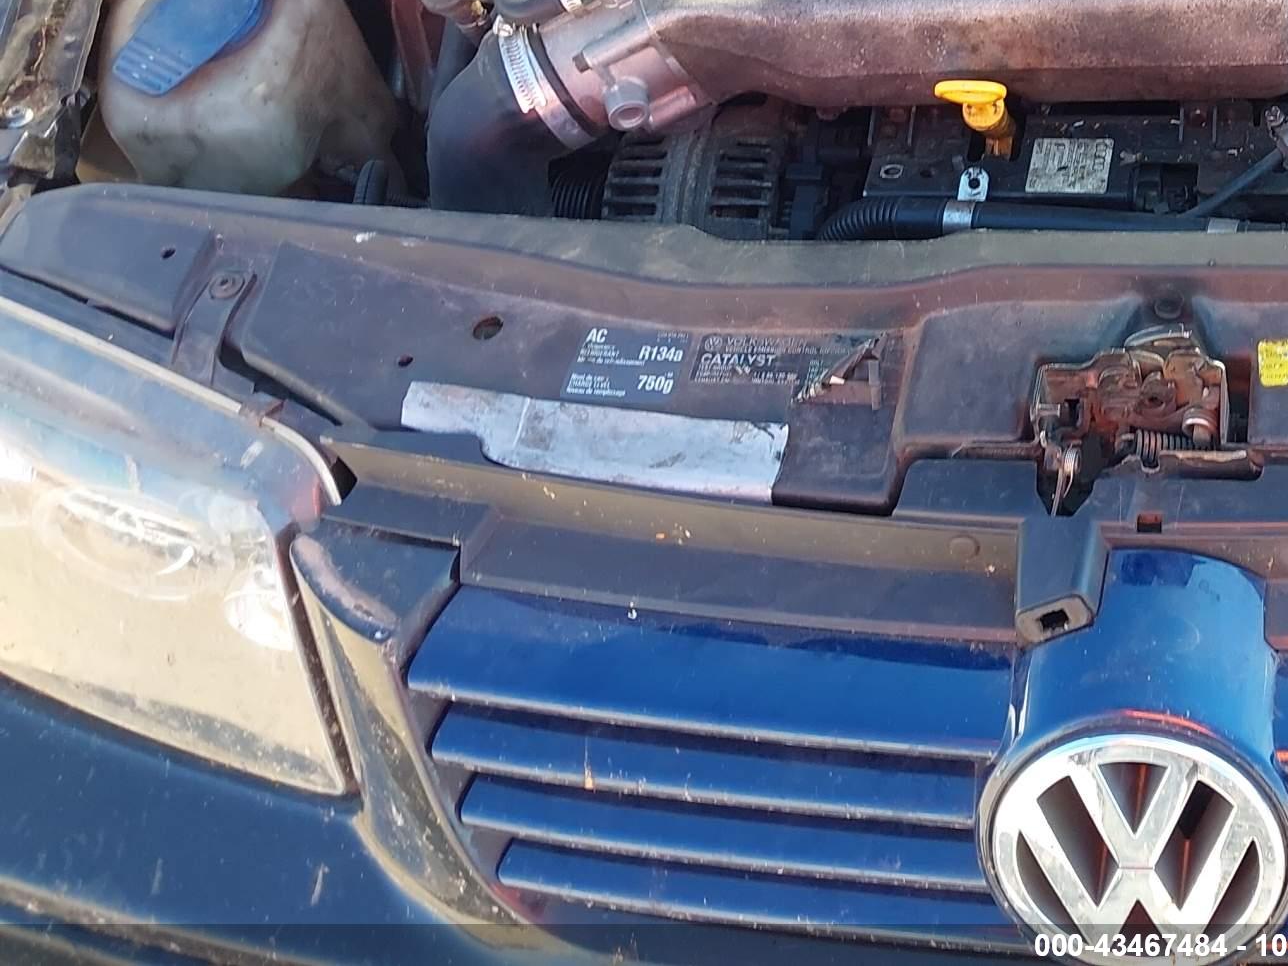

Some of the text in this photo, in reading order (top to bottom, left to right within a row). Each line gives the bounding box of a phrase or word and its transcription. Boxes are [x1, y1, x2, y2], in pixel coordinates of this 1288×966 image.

[585, 327, 608, 343] AC
[638, 344, 684, 362] R134a
[700, 353, 777, 367] CATALYST
[637, 374, 674, 394] 750g
